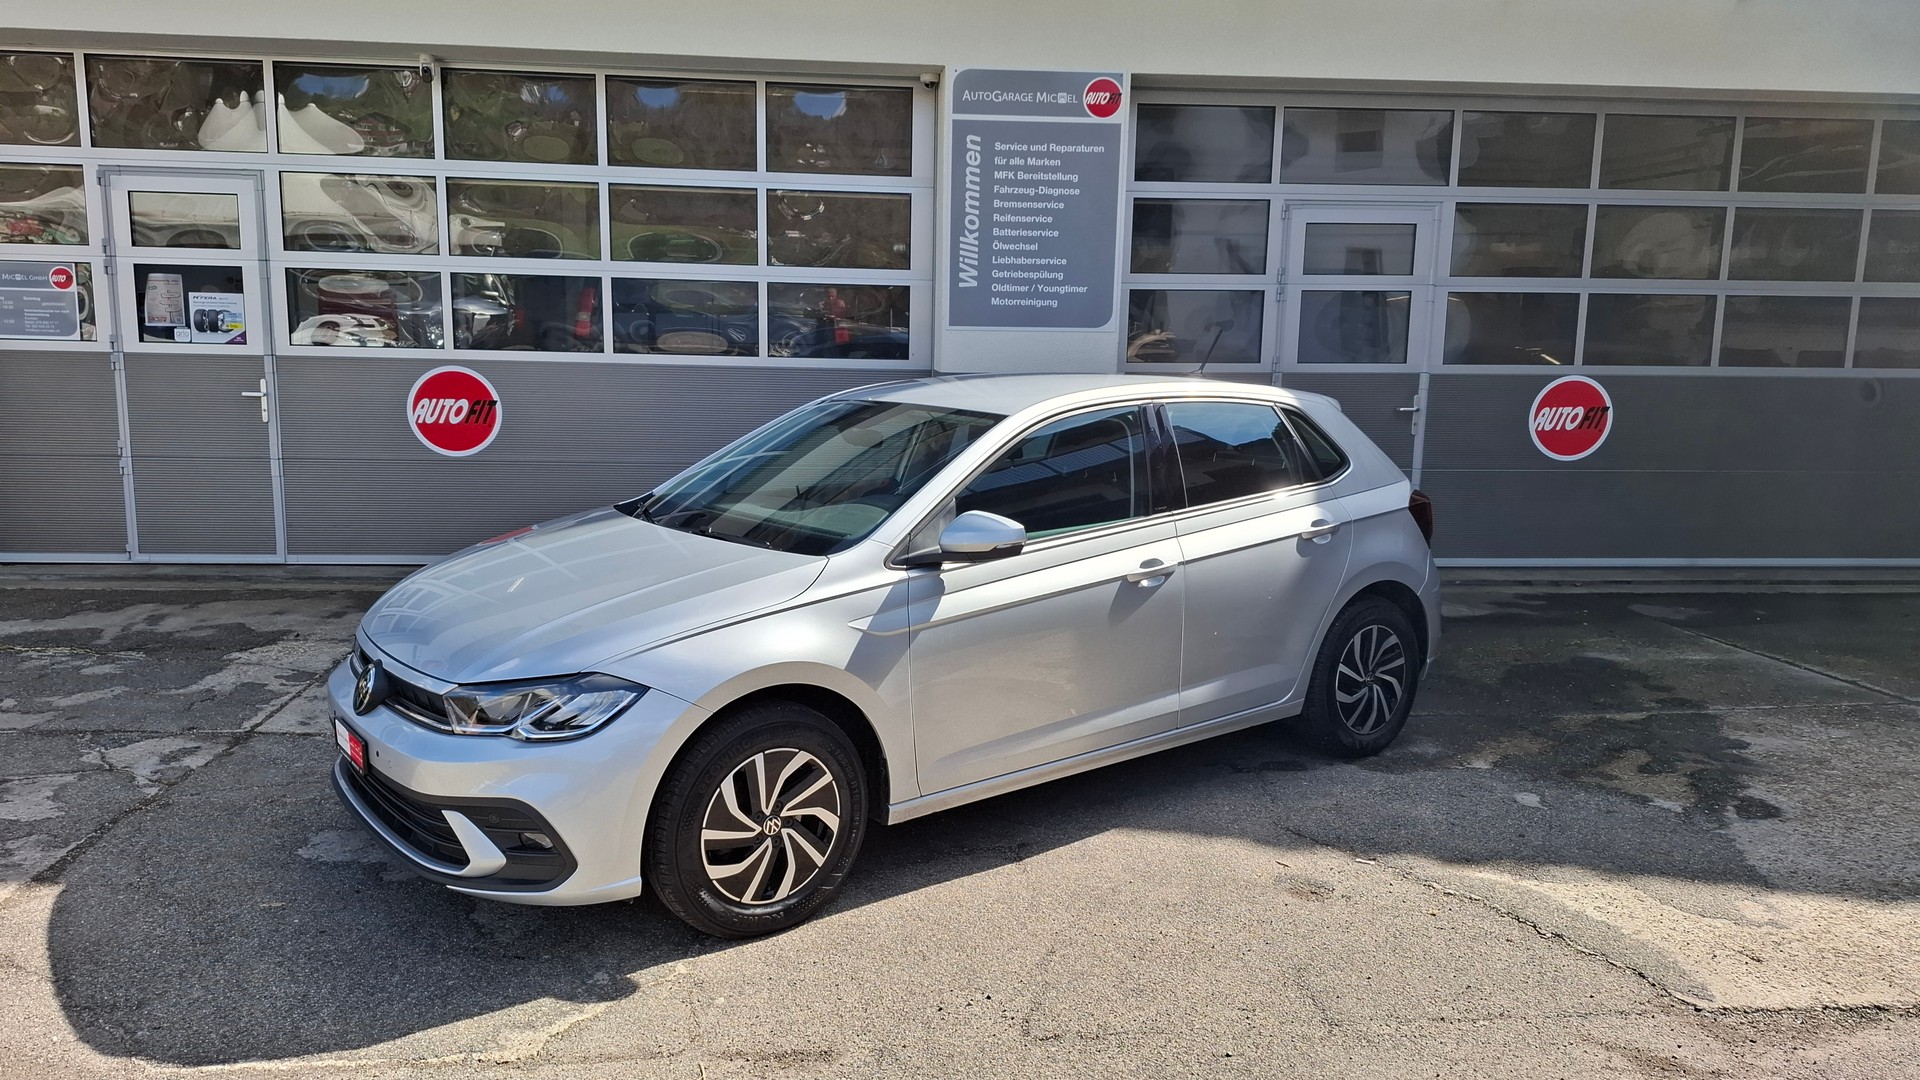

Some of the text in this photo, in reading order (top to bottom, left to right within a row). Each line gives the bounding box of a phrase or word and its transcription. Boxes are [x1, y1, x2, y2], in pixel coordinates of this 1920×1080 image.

[1085, 91, 1123, 105] AUTOFIT
[994, 142, 1105, 154] Service und Reparaturen
[994, 156, 1061, 166] für alle Marken
[994, 171, 1079, 183] MFK Bereitstellung
[993, 185, 1080, 197] Fahrzeug-Diagnose
[993, 199, 1065, 209] Bremsenservice
[958, 134, 981, 288] Willkommen
[993, 213, 1053, 223] Reifenservice
[992, 227, 1059, 237] Batterieservice
[992, 240, 1038, 251] Ölwechsel
[992, 255, 1067, 265] Liebhaberservice
[992, 269, 1064, 281] Getriebespülung
[991, 283, 1029, 292] Oldtimer
[1037, 284, 1088, 295] Youngtimer
[991, 297, 1058, 308] Motorreinigung
[413, 398, 498, 424] AUTOFIT
[1534, 406, 1611, 431] AUTOFIT
